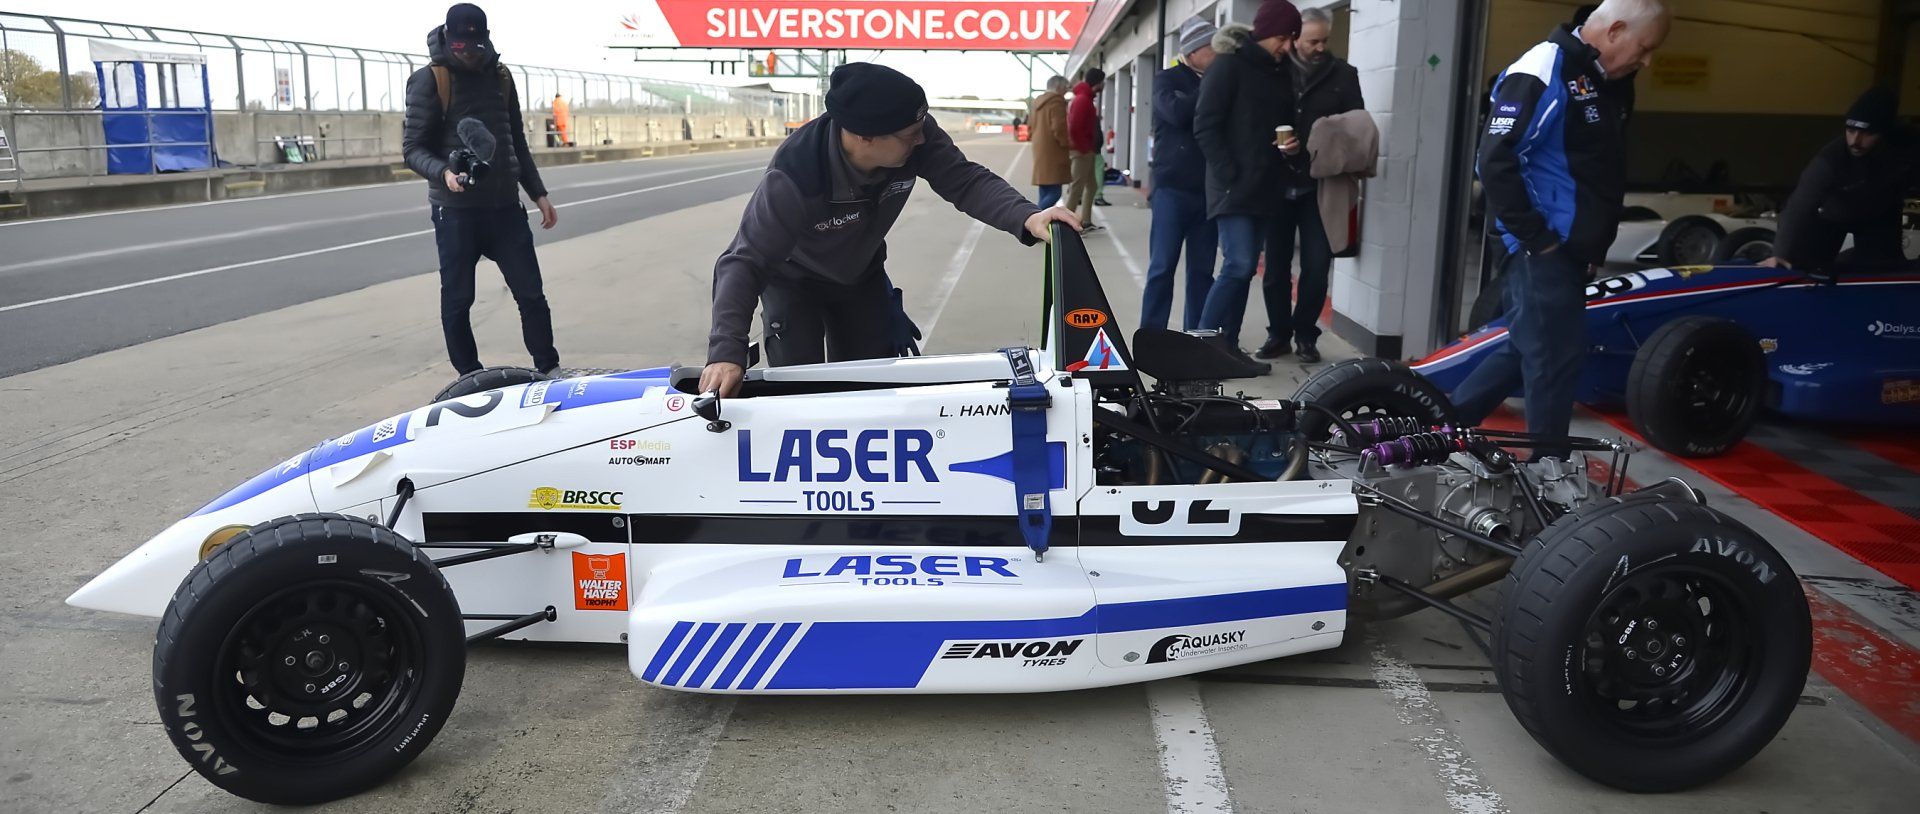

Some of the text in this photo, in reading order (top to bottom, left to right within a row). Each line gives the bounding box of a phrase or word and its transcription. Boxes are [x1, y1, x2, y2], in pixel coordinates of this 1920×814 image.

[706, 8, 1072, 41] SILVERSTONE.CO.UK
[1073, 313, 1099, 324] RAY
[939, 404, 1012, 418] L. HANN
[1393, 383, 1446, 419] AVON
[608, 455, 671, 466] AUTOSMART
[738, 429, 940, 482] LASER
[562, 490, 624, 506] BRSCC
[803, 490, 875, 511] TOOLS
[782, 555, 1019, 578] LASER
[1689, 537, 1777, 584] AVON
[579, 579, 622, 590] WALTER
[858, 577, 944, 587] TOOLS
[583, 589, 619, 599] HAYES
[1181, 629, 1246, 650] AQUASKY
[1618, 619, 1637, 645] GBR
[972, 639, 1084, 659] AVON
[1181, 643, 1248, 658] Underwater Inspection
[1022, 657, 1067, 668] TYRES
[320, 674, 347, 694] GBR
[176, 693, 239, 776] AVON
